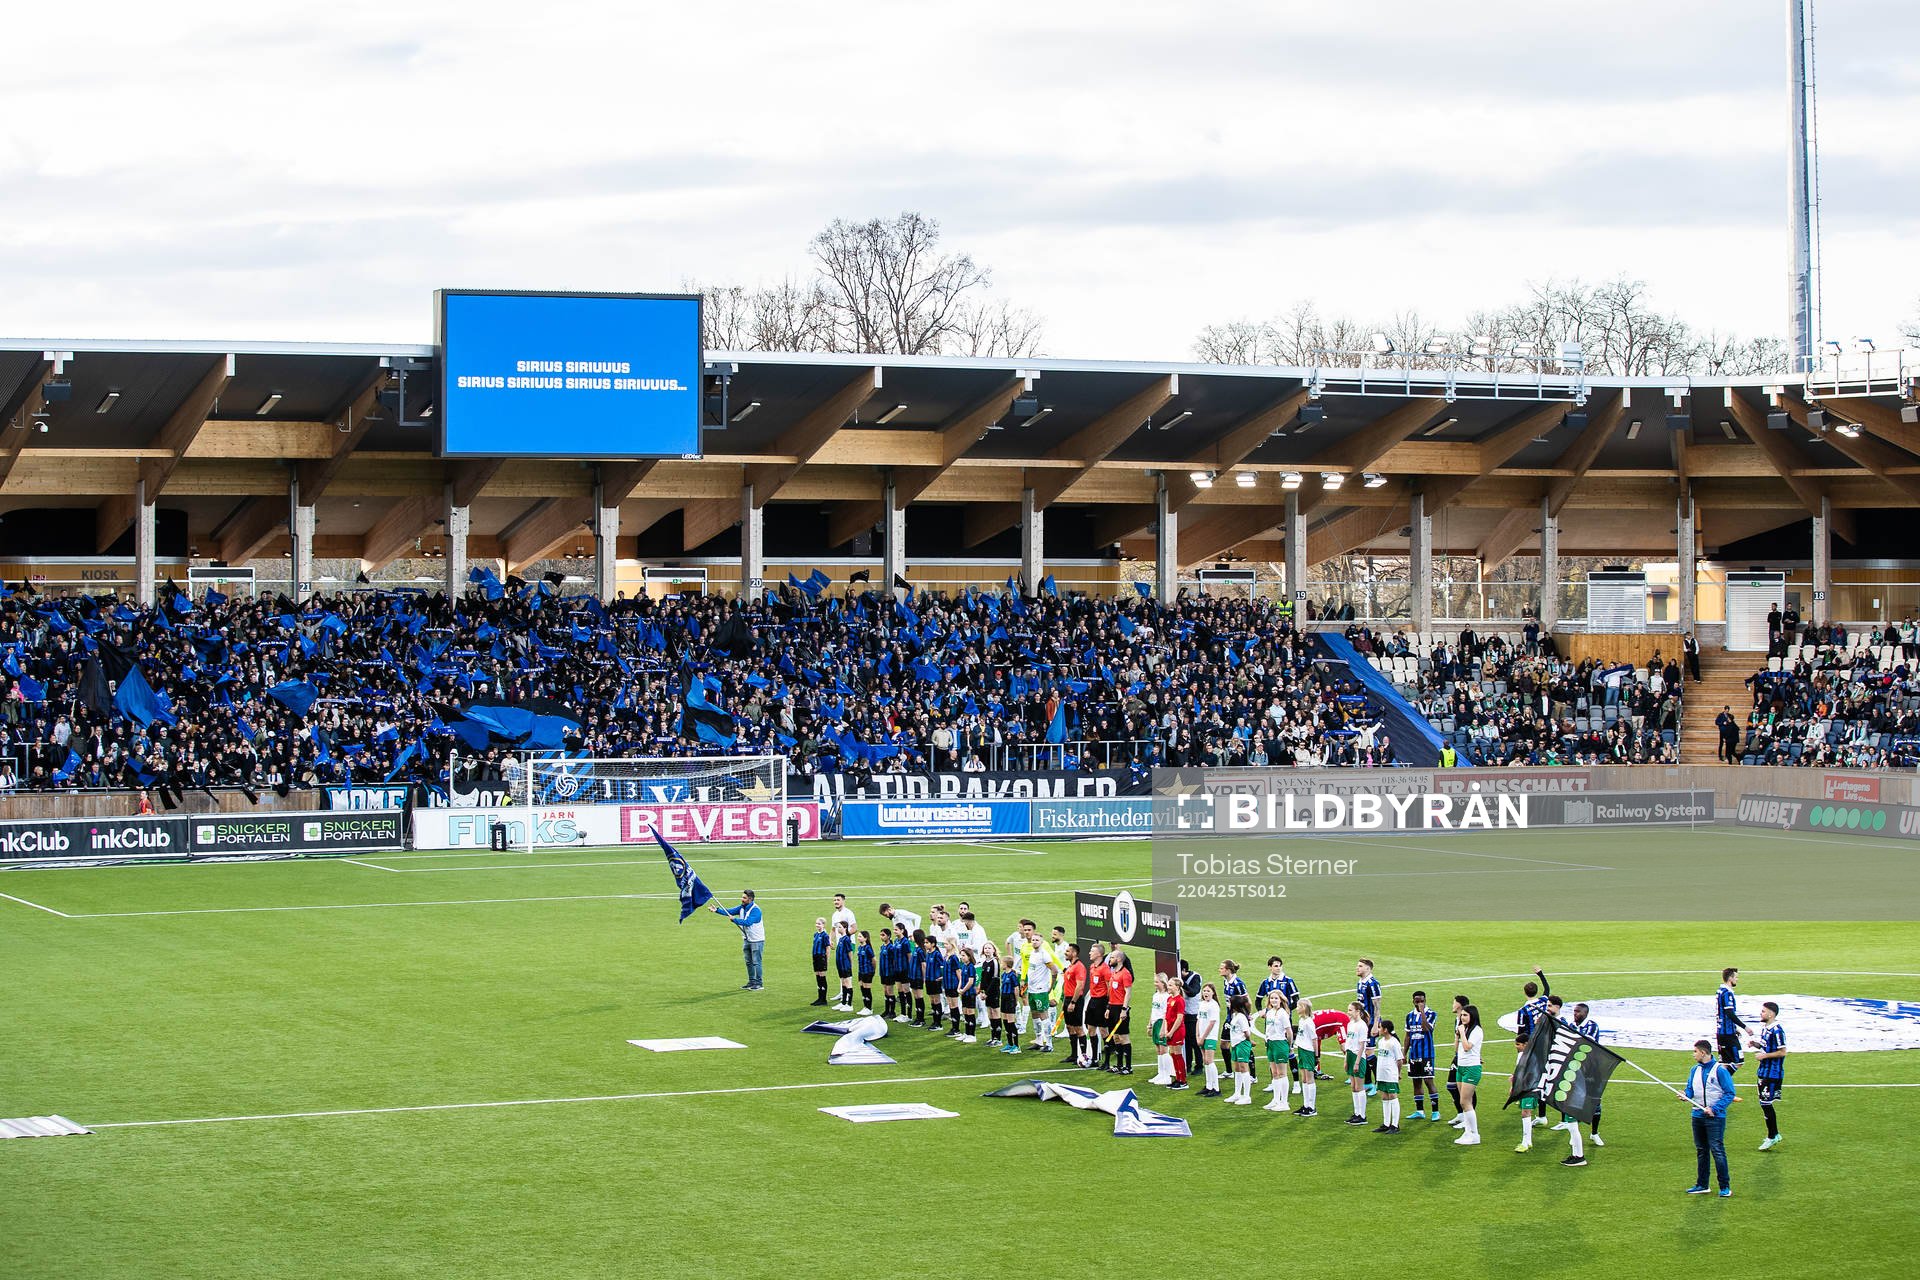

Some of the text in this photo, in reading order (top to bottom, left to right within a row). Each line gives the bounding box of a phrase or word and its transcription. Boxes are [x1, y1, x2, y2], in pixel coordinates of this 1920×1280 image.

[517, 360, 630, 374] SIRIUS SIRIUUUS
[457, 376, 504, 388] SIRIUS
[507, 377, 562, 389] SIRIUUS
[565, 378, 611, 390] SIRIUS
[81, 569, 119, 581] KIOSK
[300, 582, 311, 592] 21
[750, 577, 762, 588] 20
[1296, 590, 1306, 600] 19
[1814, 591, 1825, 600] 18
[1276, 778, 1316, 787] SVENSK
[878, 803, 992, 827] Lundagrossisten
[1596, 804, 1706, 820] Railway System
[1738, 800, 1802, 825] UNIBET
[323, 820, 396, 832] SNICKERI
[630, 806, 811, 839] BEVEGO
[217, 823, 290, 835] SNICKERI
[323, 829, 396, 841] PORTALEN
[91, 827, 171, 849] inkClub
[217, 832, 290, 844] PORTALEN
[1080, 902, 1108, 920] UNIBET
[1141, 911, 1171, 929] UNIBET
